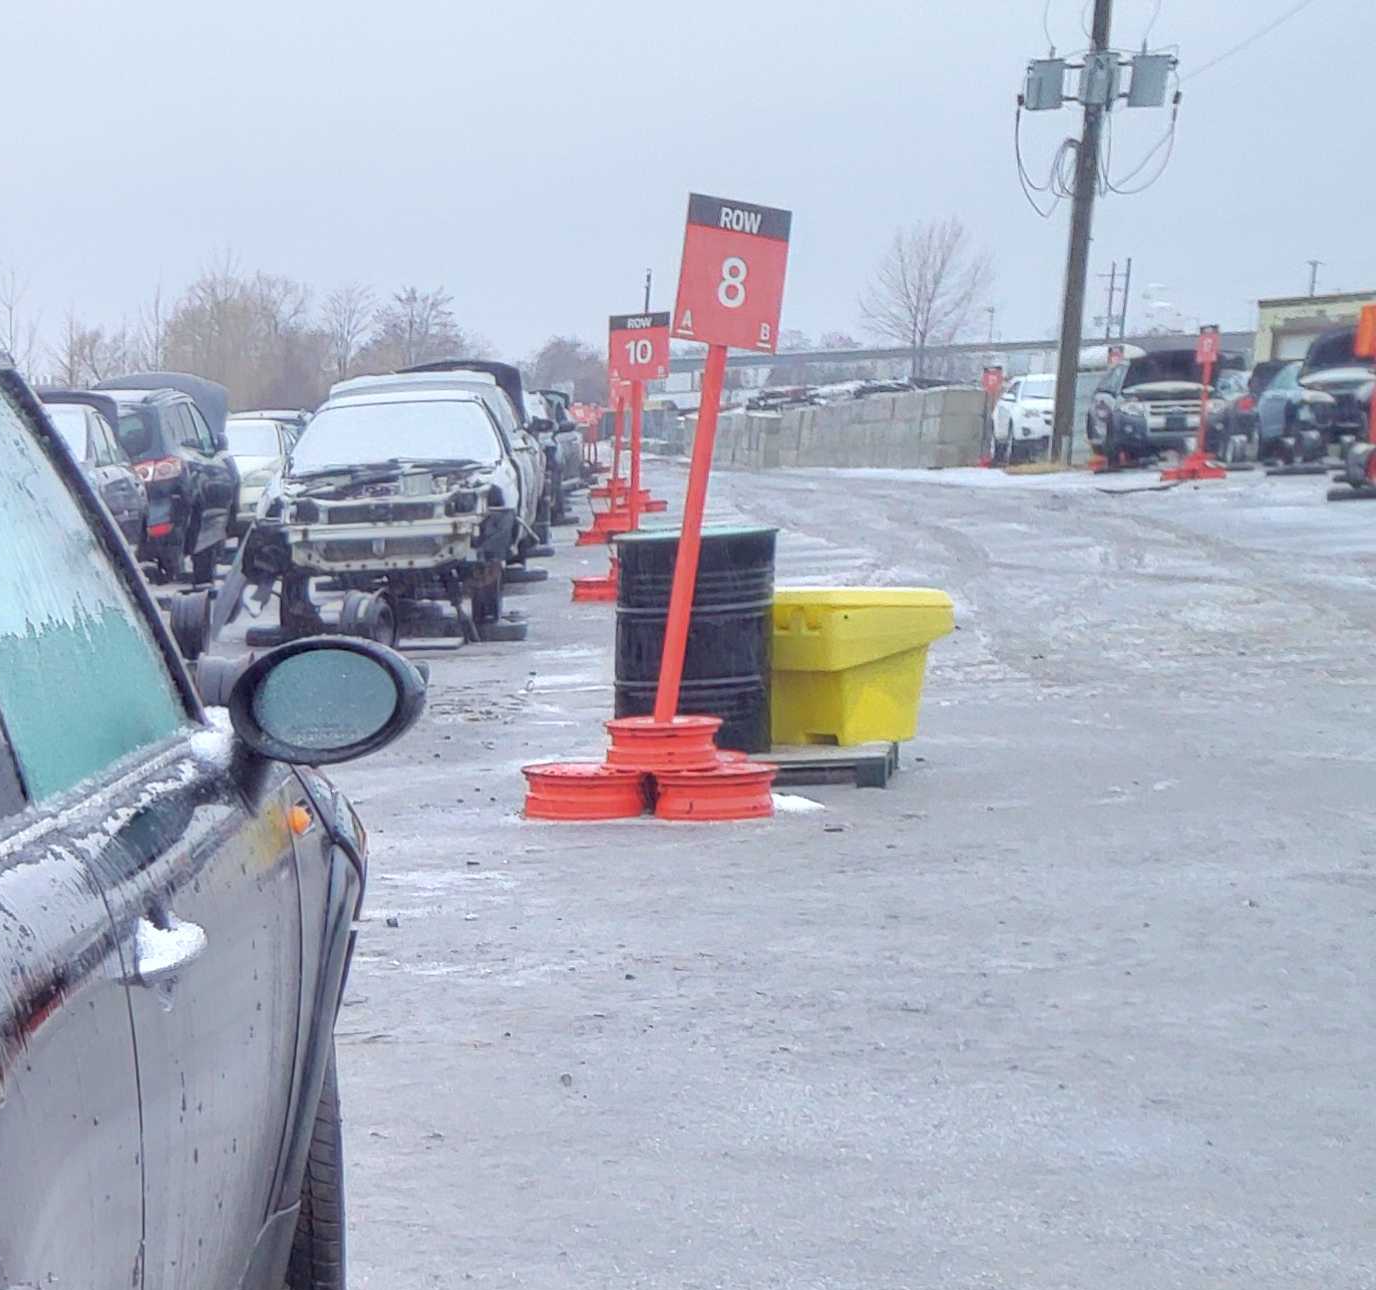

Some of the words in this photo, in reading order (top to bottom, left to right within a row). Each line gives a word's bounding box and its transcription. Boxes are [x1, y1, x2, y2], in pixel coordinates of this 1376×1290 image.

[719, 207, 762, 233] ROW
[718, 256, 748, 308] 8
[627, 317, 652, 328] ROW
[681, 309, 693, 328] A
[761, 324, 770, 341] B
[625, 340, 653, 365] 10
